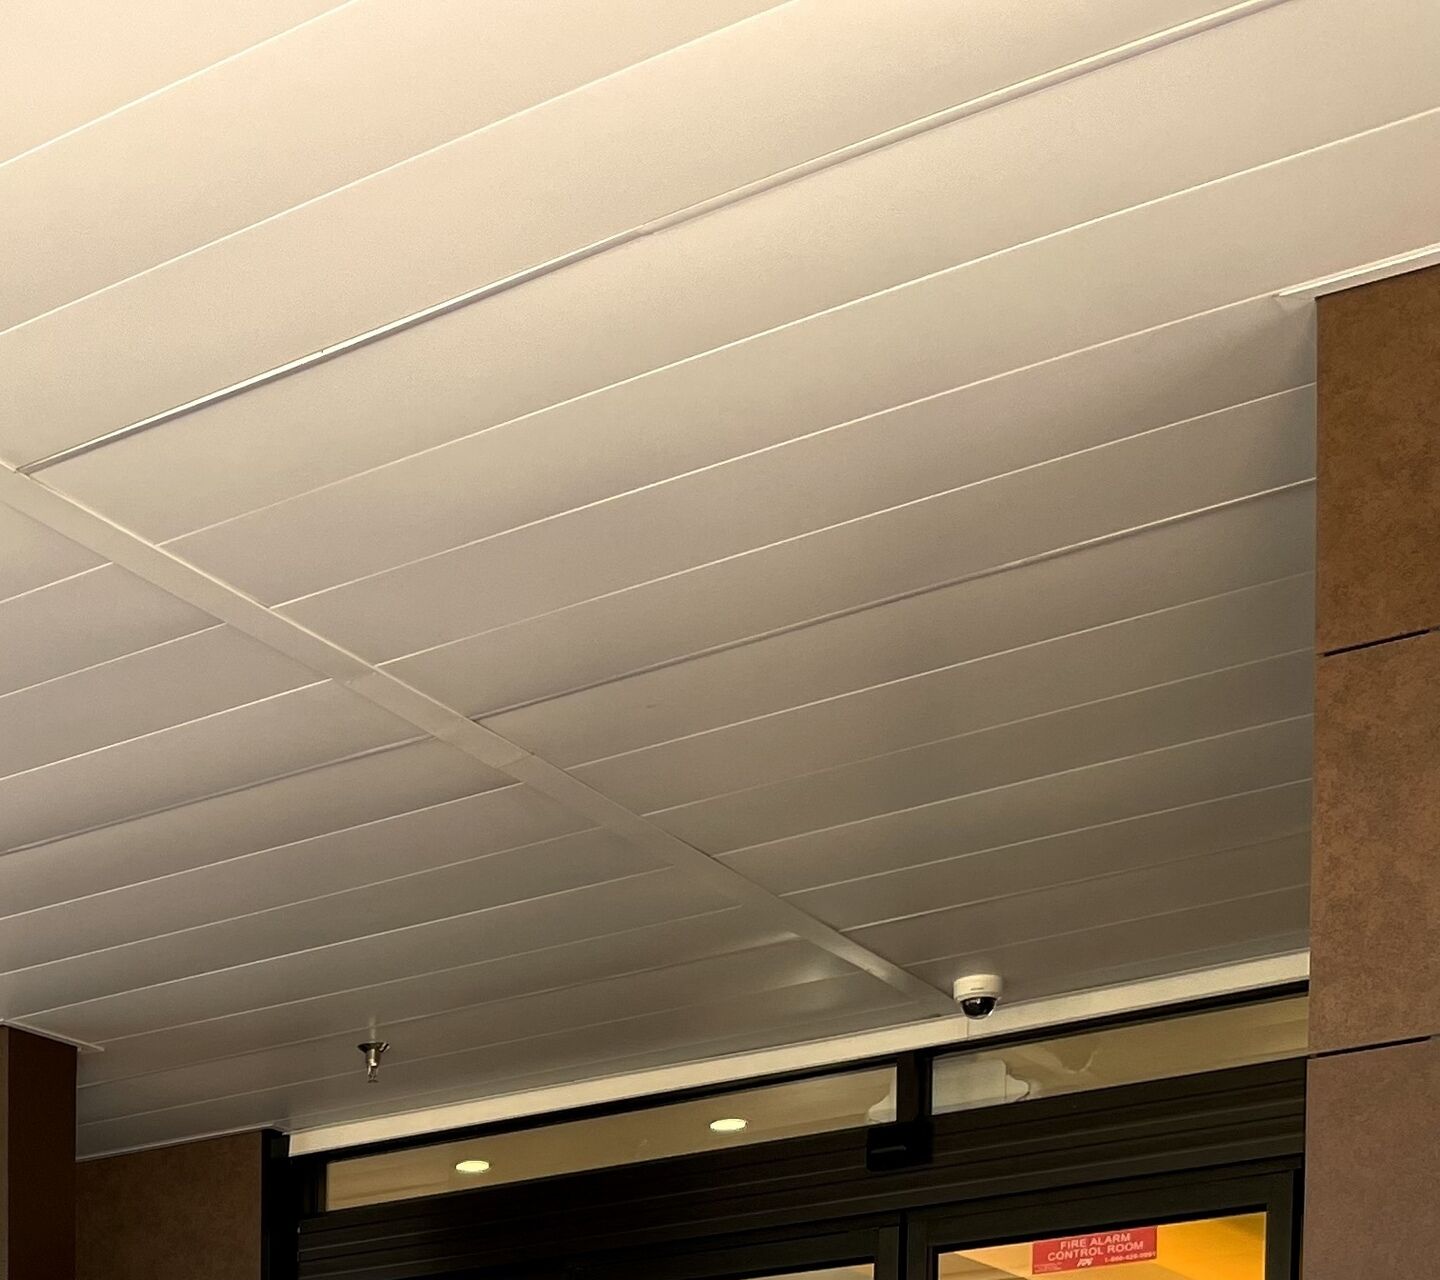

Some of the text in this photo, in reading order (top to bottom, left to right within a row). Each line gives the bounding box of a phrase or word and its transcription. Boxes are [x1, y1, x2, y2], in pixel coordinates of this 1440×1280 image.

[1060, 1233, 1131, 1250] FIRE ALARM
[1047, 1248, 1104, 1261] CONTROL
[1106, 1241, 1144, 1253] ROOM
